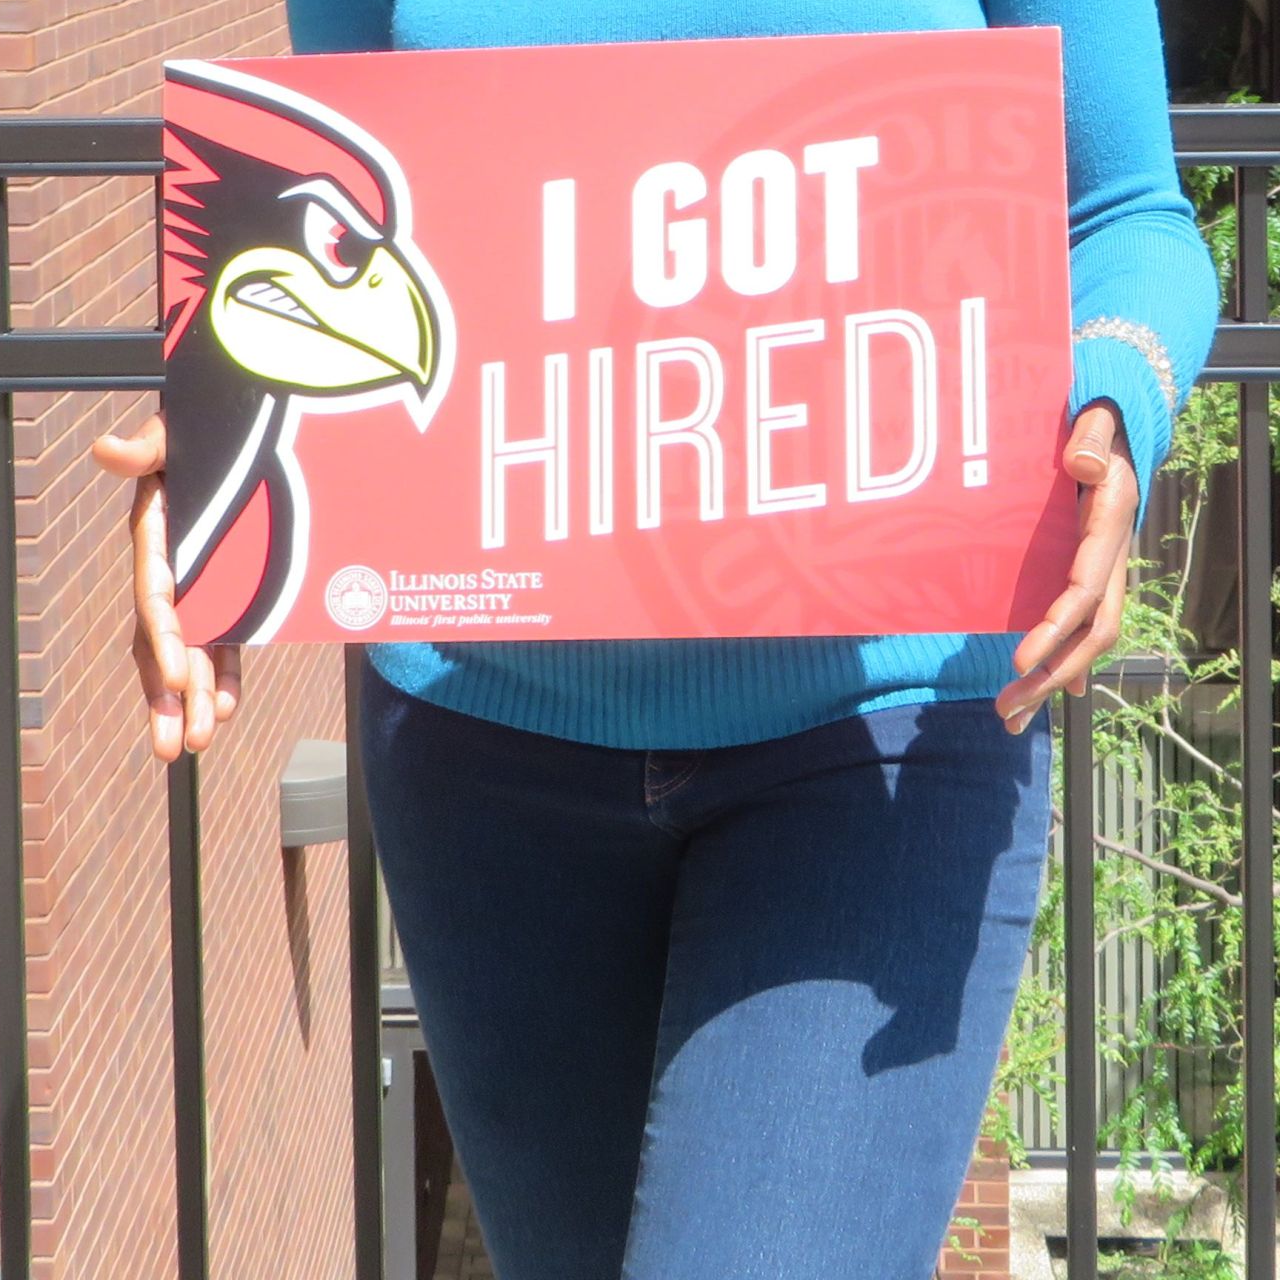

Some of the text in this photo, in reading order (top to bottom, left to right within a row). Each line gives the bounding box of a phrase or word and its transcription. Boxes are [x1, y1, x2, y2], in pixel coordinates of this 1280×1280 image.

[542, 177, 577, 322] I
[631, 135, 880, 309] GOT
[480, 296, 989, 550] HIRED!
[390, 568, 543, 591] ILLINOIS STATE
[390, 594, 512, 612] UNIVERSITY
[432, 614, 456, 628] first
[457, 613, 493, 628] public
[495, 613, 552, 626] university
